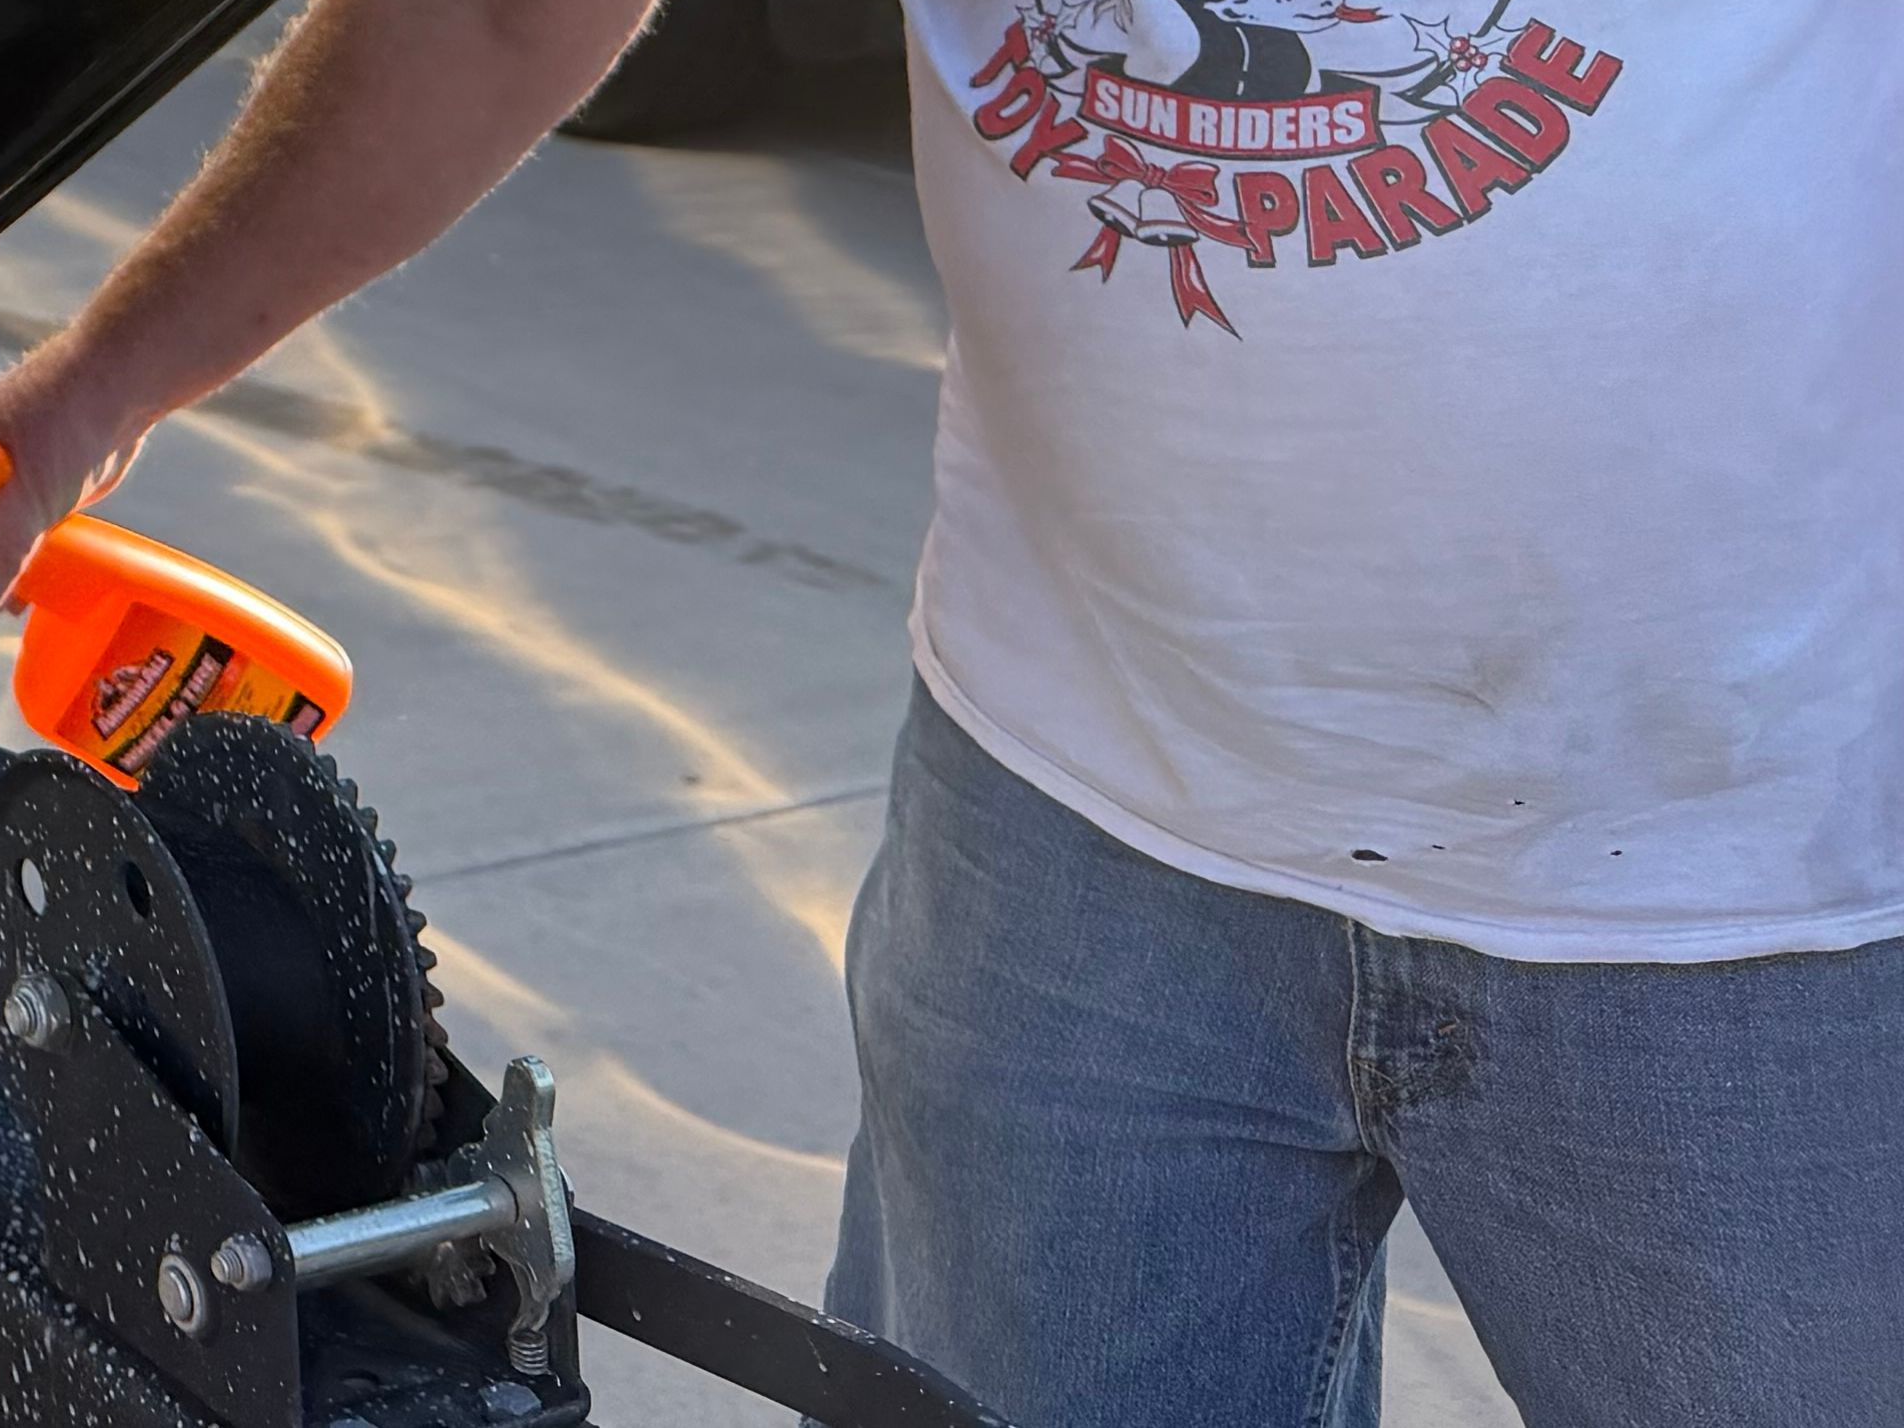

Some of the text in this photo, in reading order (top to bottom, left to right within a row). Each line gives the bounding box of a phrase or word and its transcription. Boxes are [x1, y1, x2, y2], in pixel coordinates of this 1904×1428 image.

[969, 17, 1623, 269] TOY PARADE
[1095, 79, 1366, 150] SUN RIDERS
